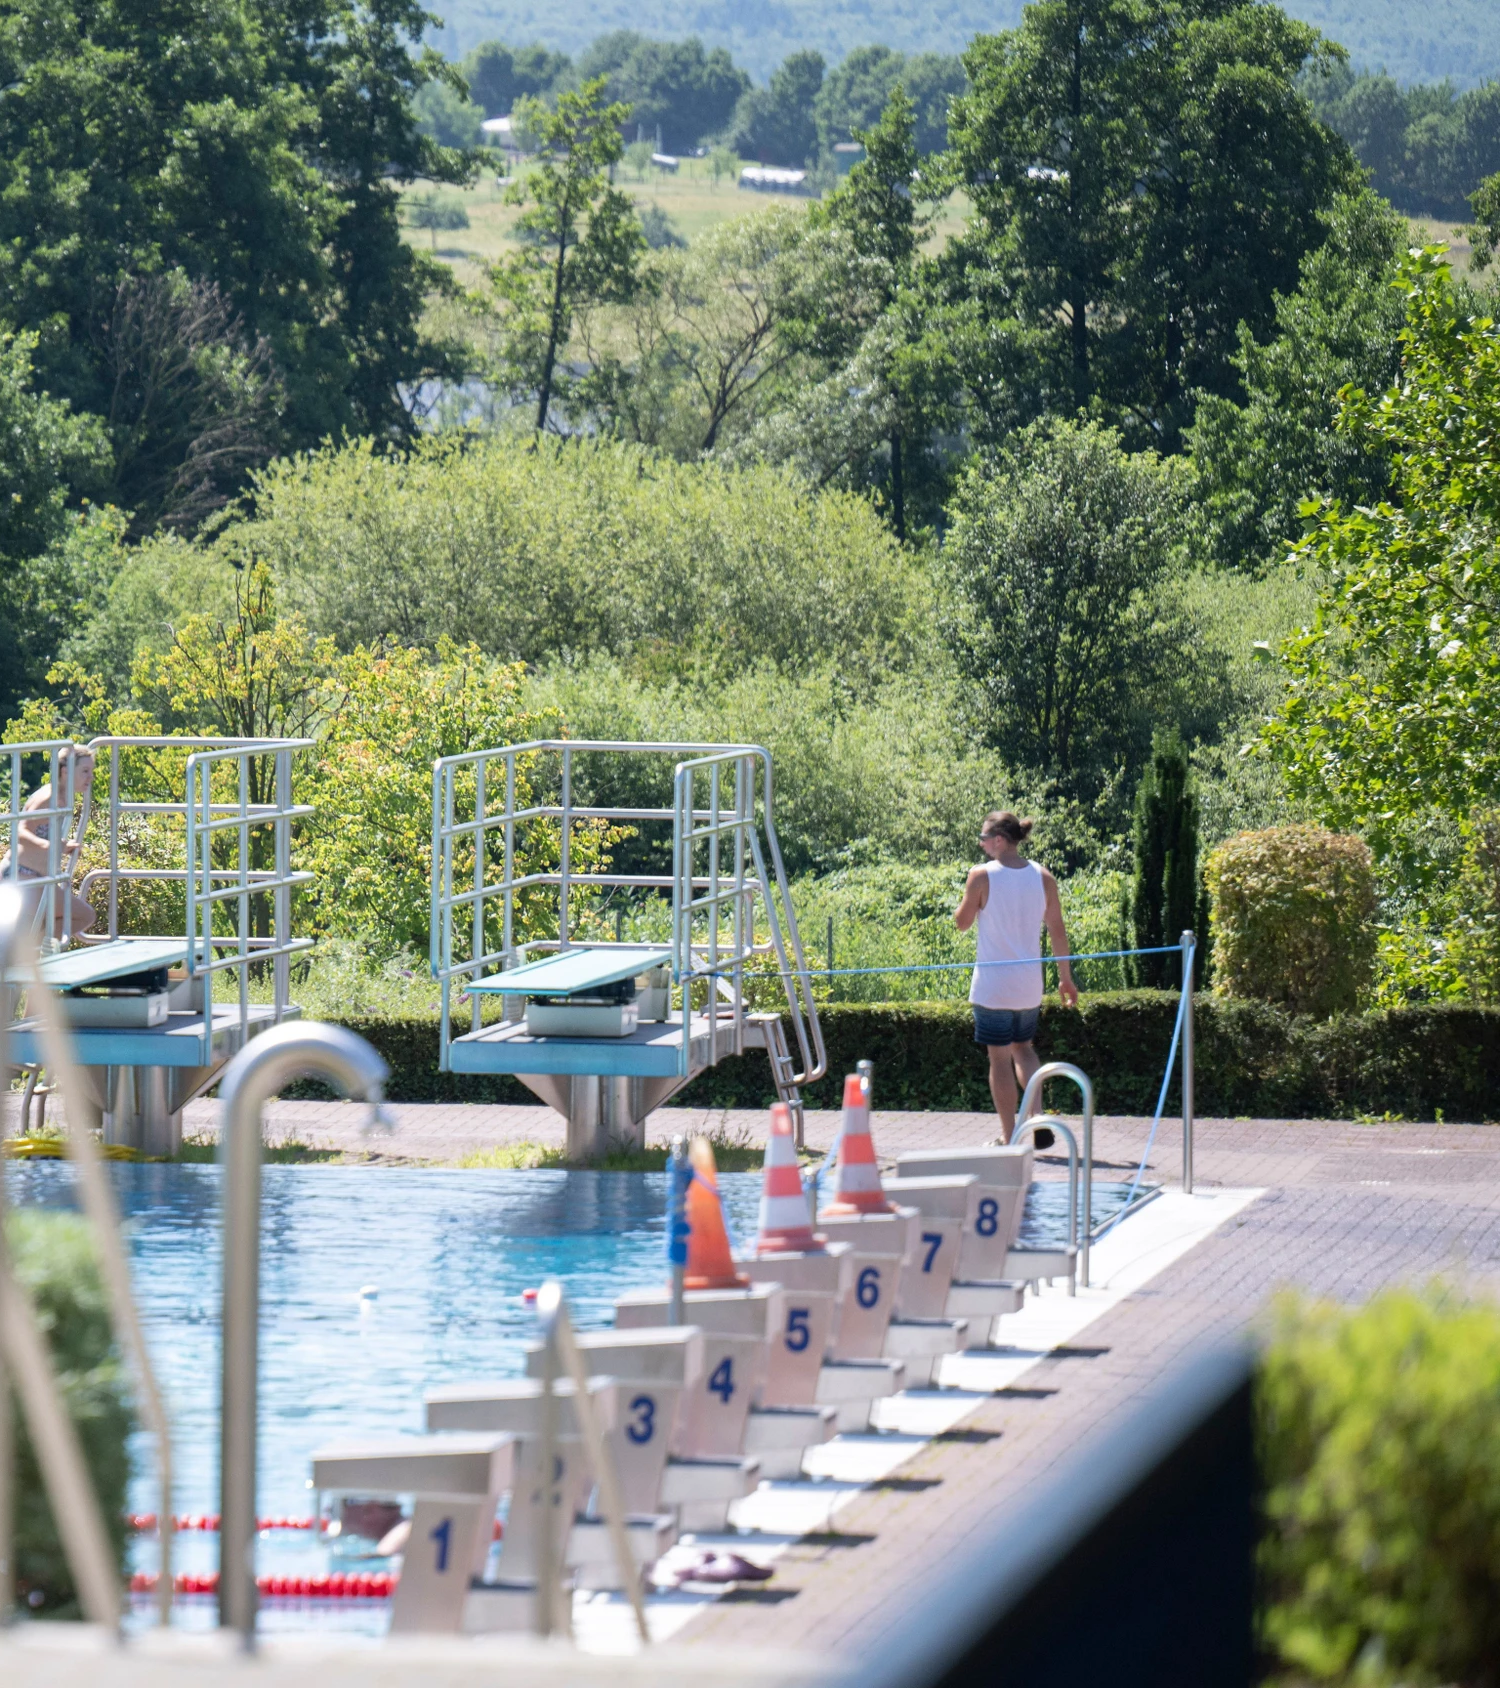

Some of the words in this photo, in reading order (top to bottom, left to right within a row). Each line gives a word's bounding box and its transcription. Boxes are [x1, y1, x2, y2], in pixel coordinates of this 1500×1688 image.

[975, 1198, 999, 1238] 8
[922, 1233, 943, 1272] 7
[856, 1267, 880, 1309] 6
[786, 1308, 811, 1352] 5
[709, 1358, 735, 1403] 4
[627, 1396, 656, 1444] 3
[432, 1519, 451, 1571] 1
